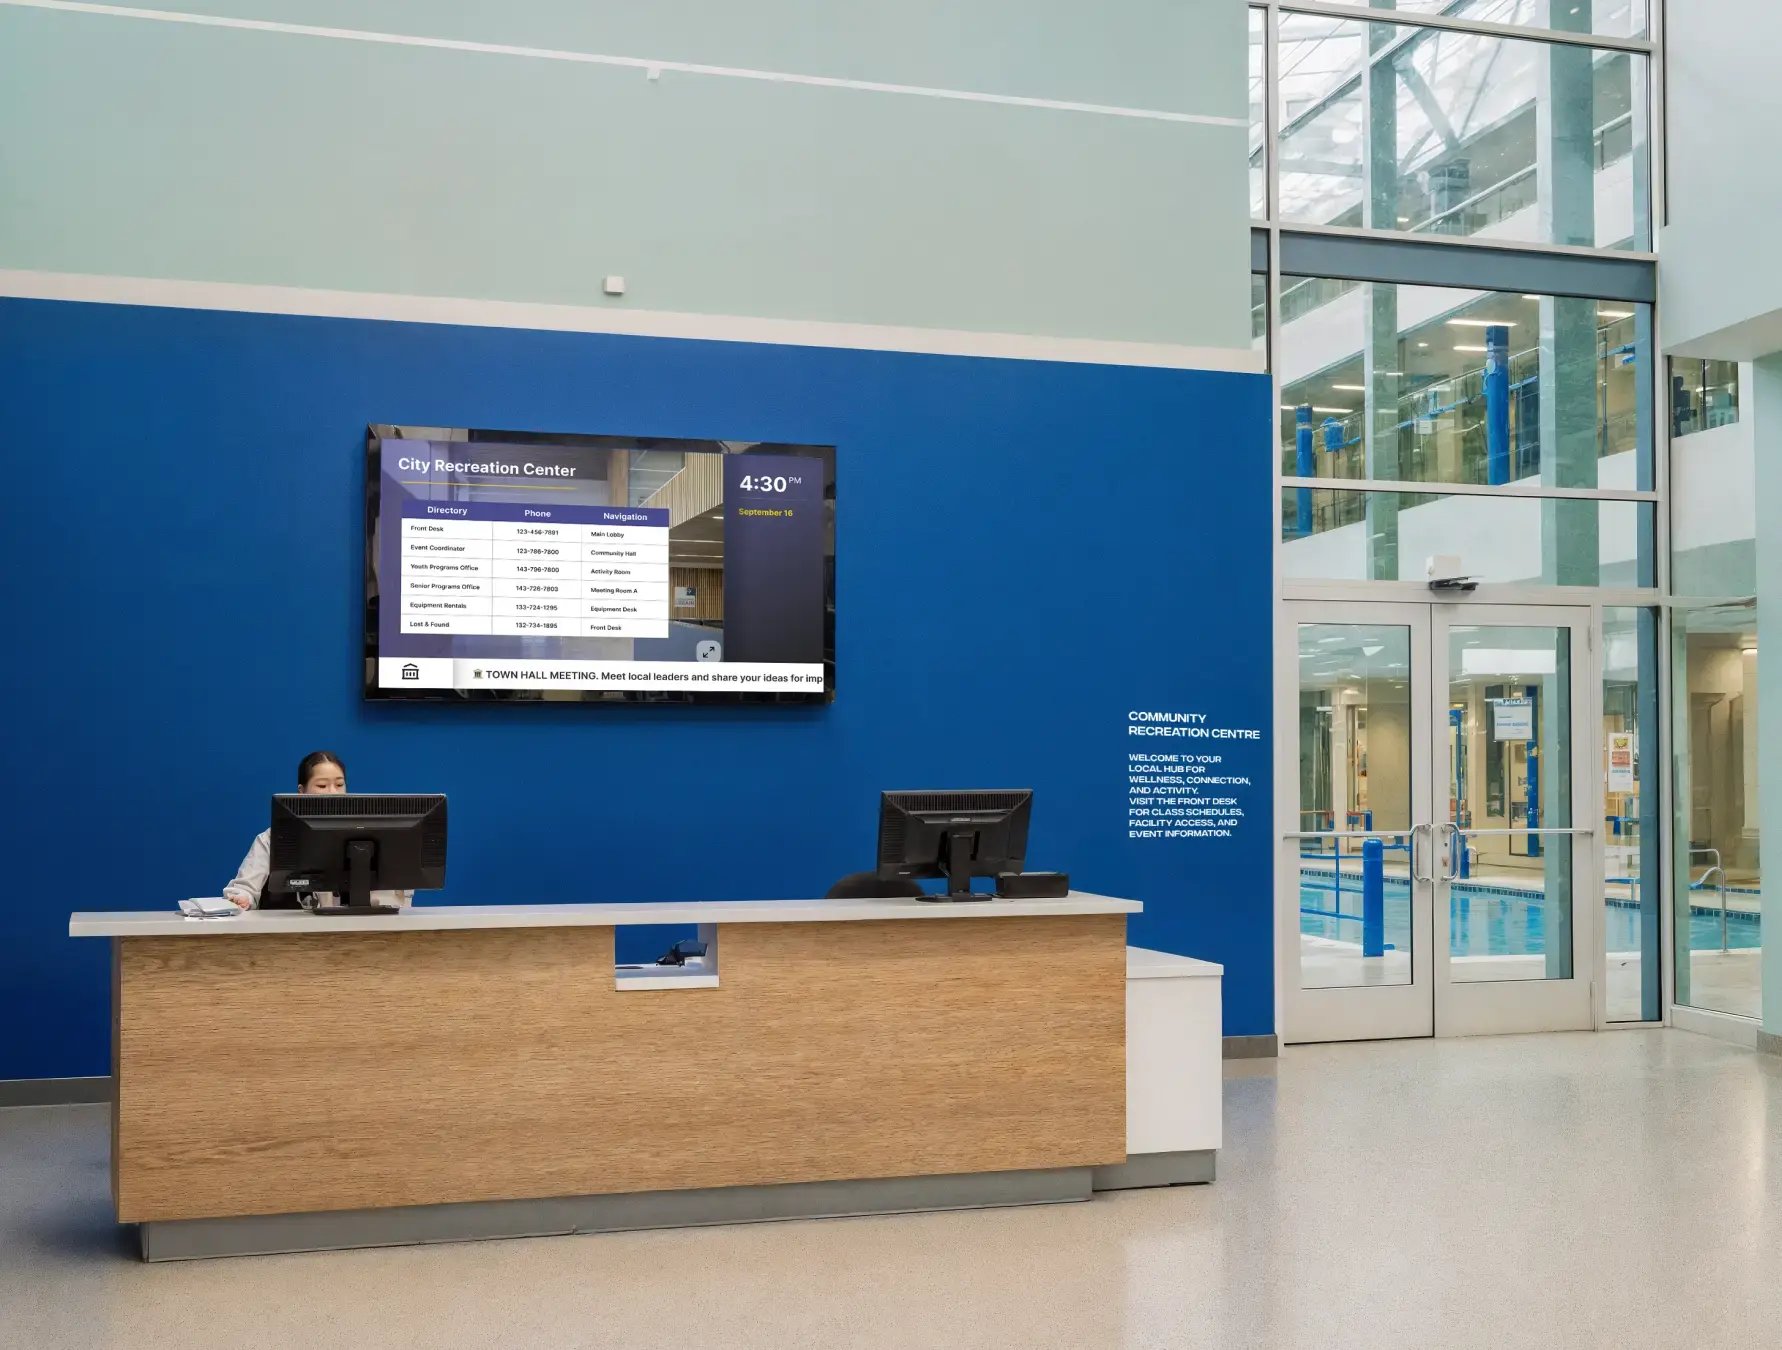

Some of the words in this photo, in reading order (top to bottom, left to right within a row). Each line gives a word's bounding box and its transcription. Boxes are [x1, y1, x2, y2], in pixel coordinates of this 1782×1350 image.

[399, 458, 431, 474] City
[435, 459, 519, 475] Recreation
[524, 463, 576, 476] Center
[740, 476, 786, 492] 4:30
[428, 507, 467, 515] Directory
[739, 508, 782, 516] September
[604, 513, 647, 521] Navigation
[486, 670, 518, 679] TOWN
[521, 670, 547, 680] HALL
[550, 671, 598, 681] MEETING.
[602, 672, 625, 681] Meet
[629, 672, 651, 681] local
[654, 673, 688, 681] leaders
[691, 673, 709, 681] and
[712, 673, 737, 682] share
[740, 675, 760, 684] your
[764, 673, 788, 682] ideas
[791, 674, 804, 682] for
[806, 674, 823, 684] imp
[1129, 711, 1206, 723] COMMUNITY
[1129, 726, 1209, 738] RECREATION
[1212, 729, 1260, 739] CENTRE
[1129, 754, 1178, 762] WELCOME
[1129, 776, 1185, 785] WELLNESS,
[1186, 777, 1251, 786] CONNECTION,
